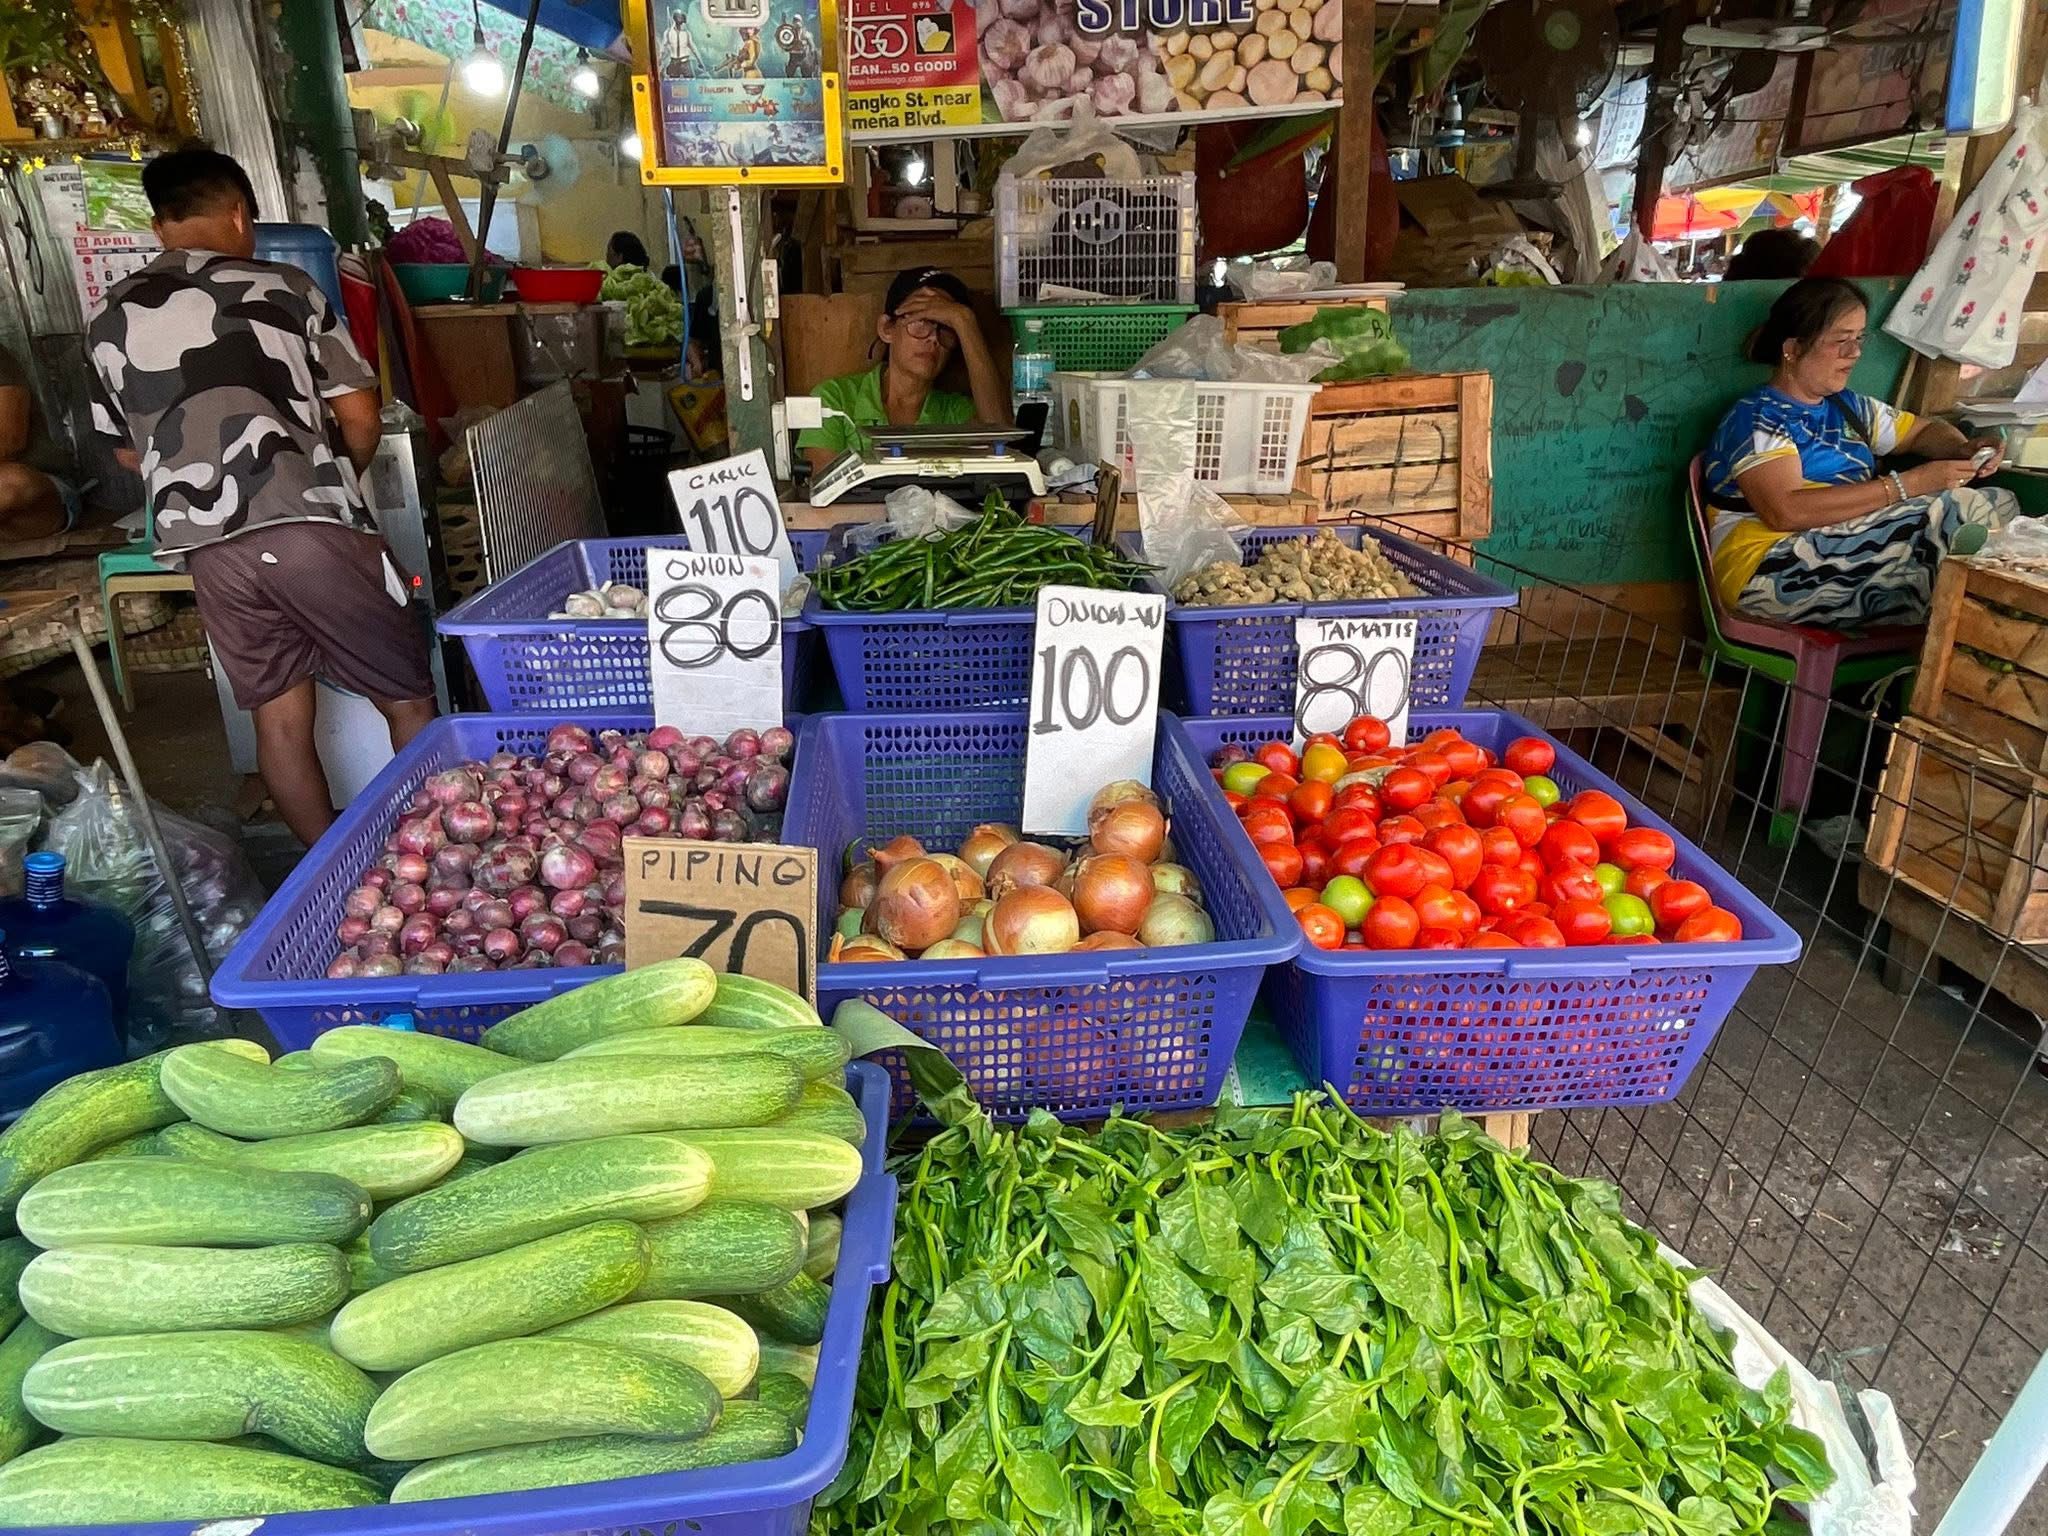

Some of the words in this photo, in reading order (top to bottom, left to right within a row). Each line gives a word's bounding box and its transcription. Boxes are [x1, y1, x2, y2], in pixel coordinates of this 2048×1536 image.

[914, 60, 957, 72] GOOD!
[905, 92, 929, 108] St.
[933, 92, 972, 106] near
[849, 113, 899, 129] meña
[904, 110, 946, 126] Blvd.
[93, 236, 136, 246] APRIL
[86, 271, 94, 282] 5
[104, 270, 113, 282] 6
[87, 286, 100, 297] 12
[689, 486, 779, 557] 110
[665, 556, 744, 580] ONION
[654, 582, 780, 669] 80
[1317, 619, 1413, 642] TAMATIS
[1033, 645, 1151, 735] 100
[1296, 642, 1410, 740] 80
[641, 850, 807, 887] PIPINO
[638, 899, 808, 1000] 70
